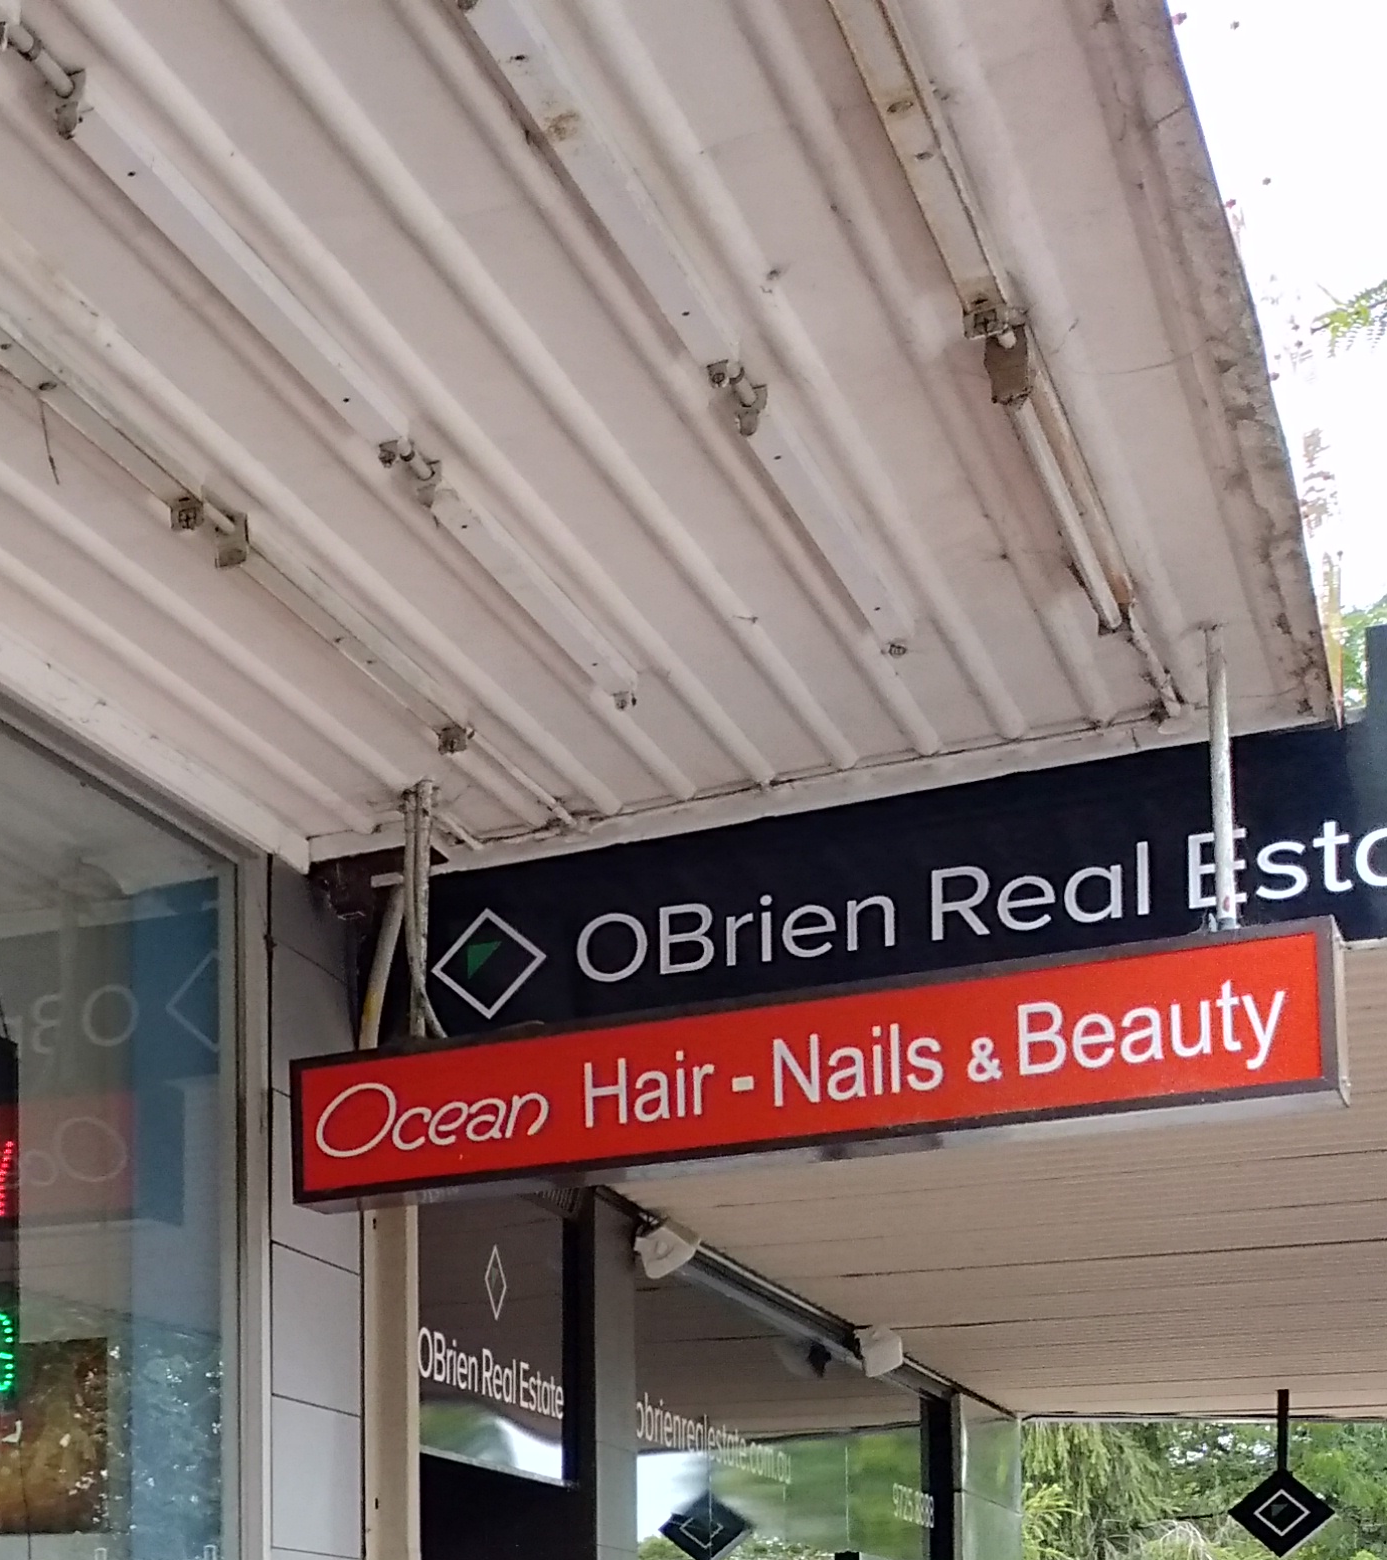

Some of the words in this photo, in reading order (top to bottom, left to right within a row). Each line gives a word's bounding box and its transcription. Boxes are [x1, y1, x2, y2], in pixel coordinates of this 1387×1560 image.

[576, 893, 896, 983] OBrien
[930, 840, 1151, 942] Real
[315, 1081, 550, 1159] Ocean
[583, 1050, 716, 1128] Hair
[772, 1023, 944, 1109] Nails
[967, 1036, 1002, 1083] &
[1017, 979, 1286, 1071] Beauty
[418, 1327, 478, 1393] OBrien
[482, 1347, 517, 1405] Real
[520, 1361, 564, 1420] Estate
